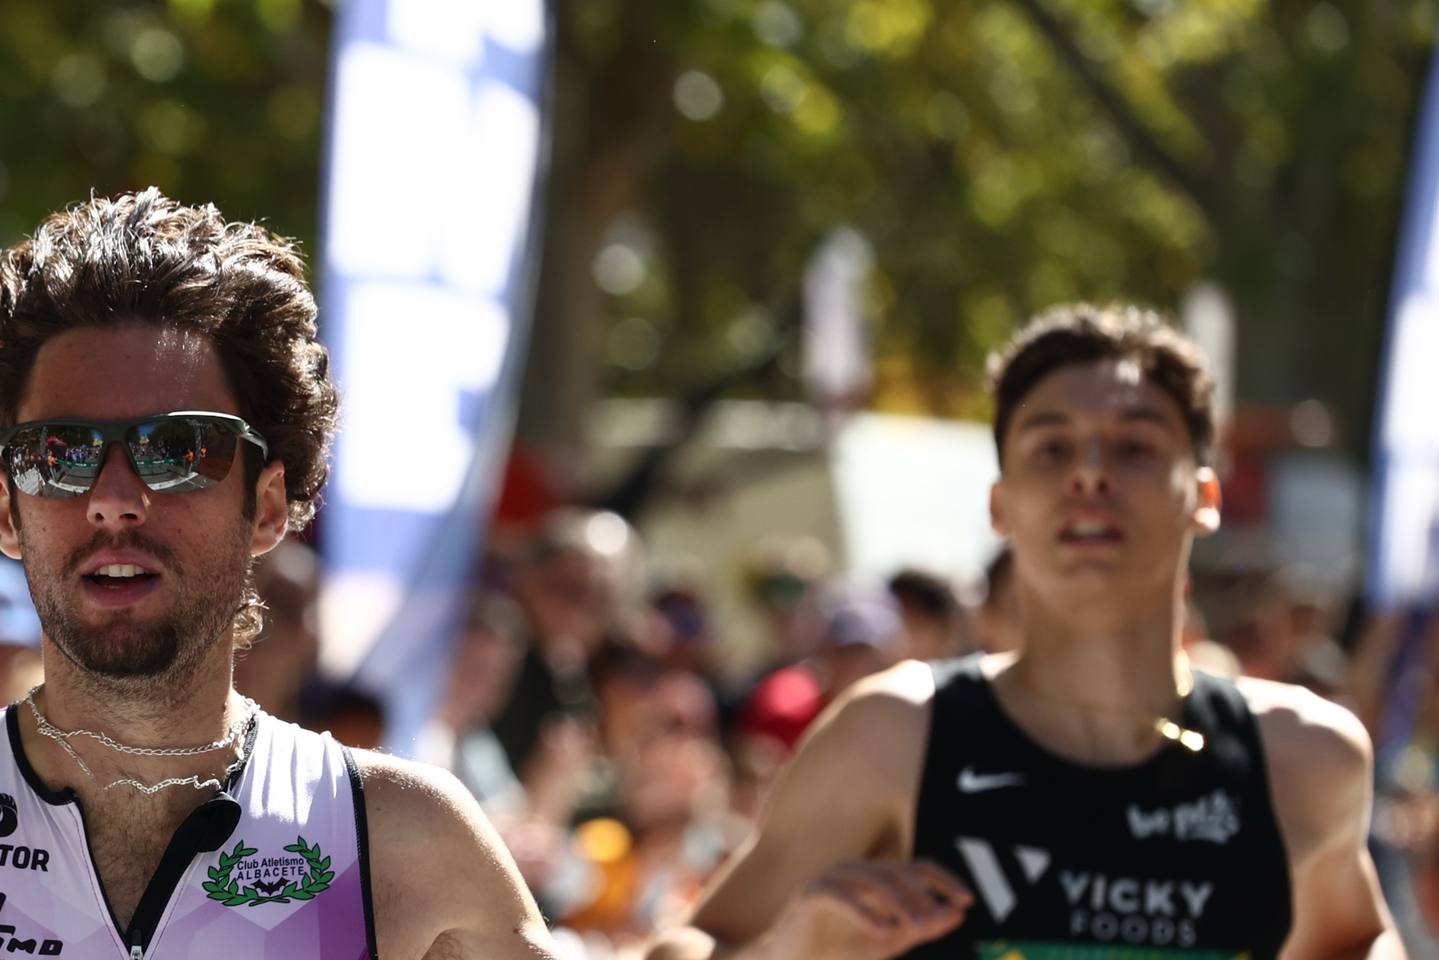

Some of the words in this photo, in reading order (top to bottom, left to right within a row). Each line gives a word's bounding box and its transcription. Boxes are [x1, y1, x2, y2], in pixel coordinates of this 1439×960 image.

[236, 866, 305, 881] ALBACETE
[237, 859, 259, 870] Club
[261, 857, 304, 868] Atletismo
[1059, 870, 1213, 919] VICKY
[1070, 908, 1197, 948] FOODS
